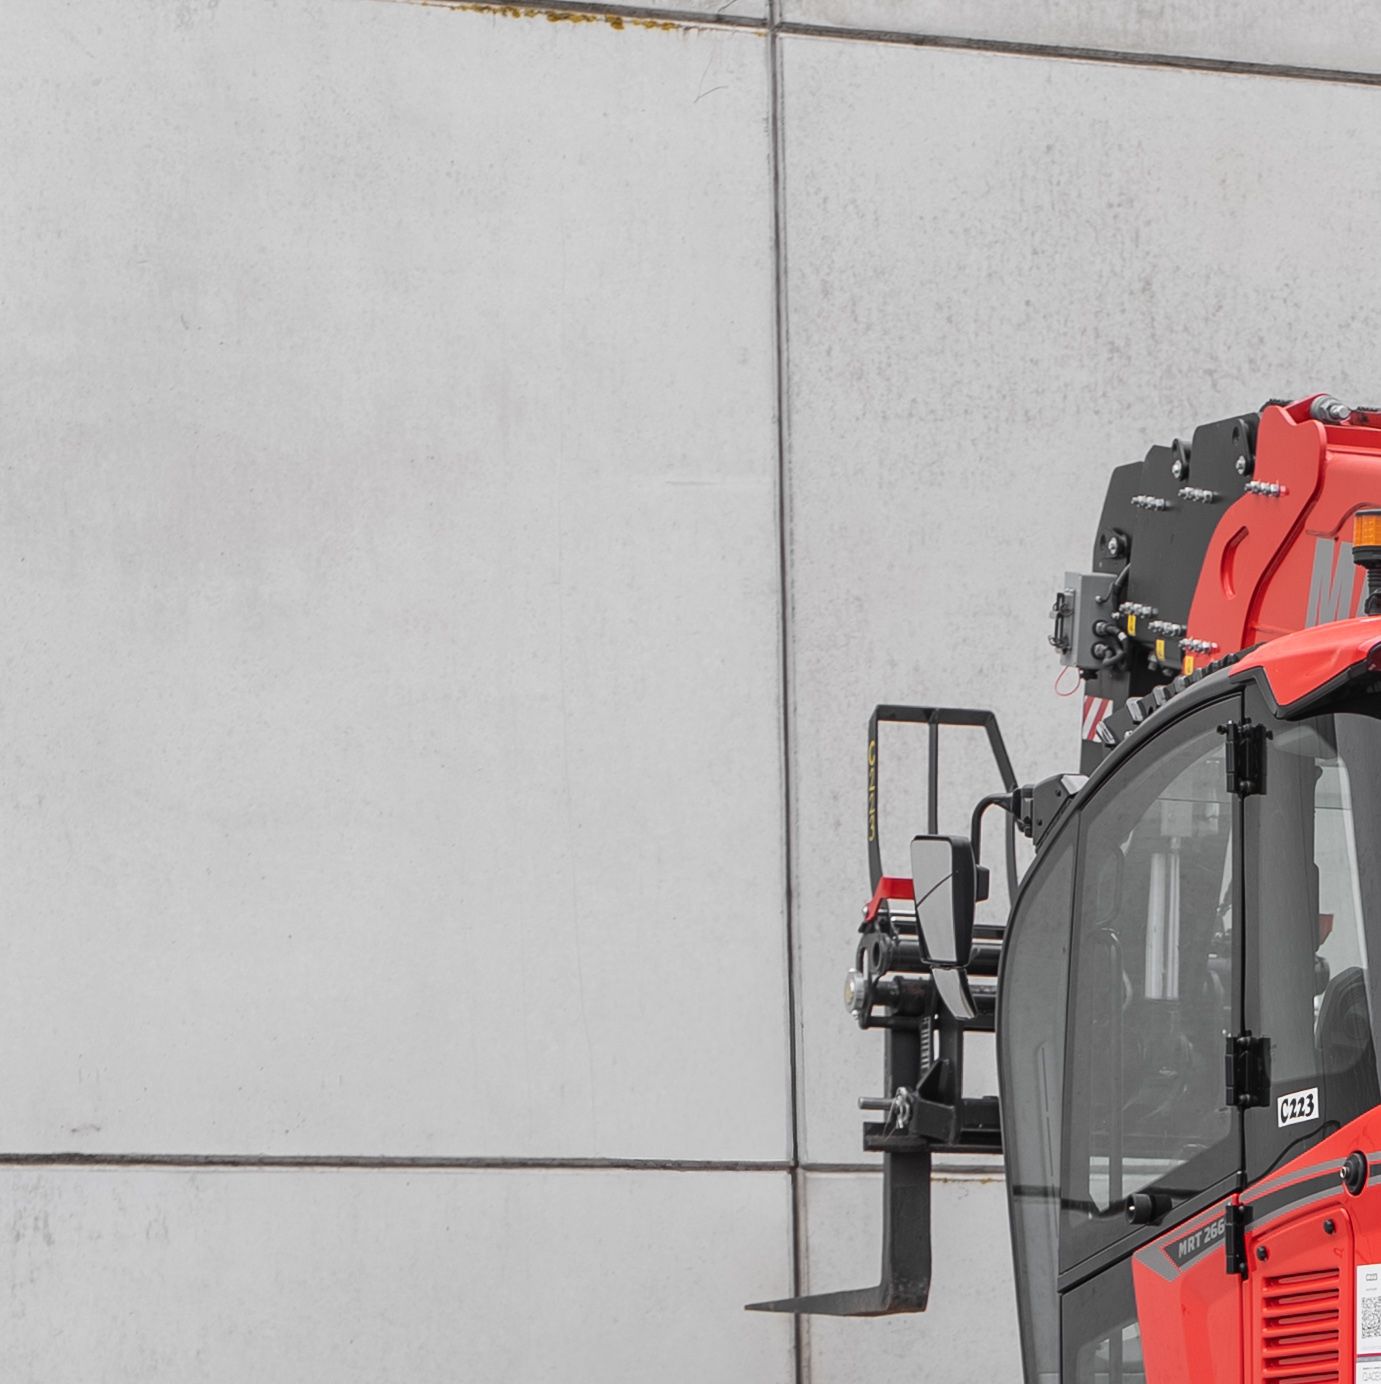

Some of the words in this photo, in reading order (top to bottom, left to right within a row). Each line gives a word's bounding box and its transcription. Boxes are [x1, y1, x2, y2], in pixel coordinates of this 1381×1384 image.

[1280, 1093, 1315, 1123] C223
[1178, 1231, 1202, 1258] MRT
[1203, 1217, 1226, 1245] 266
